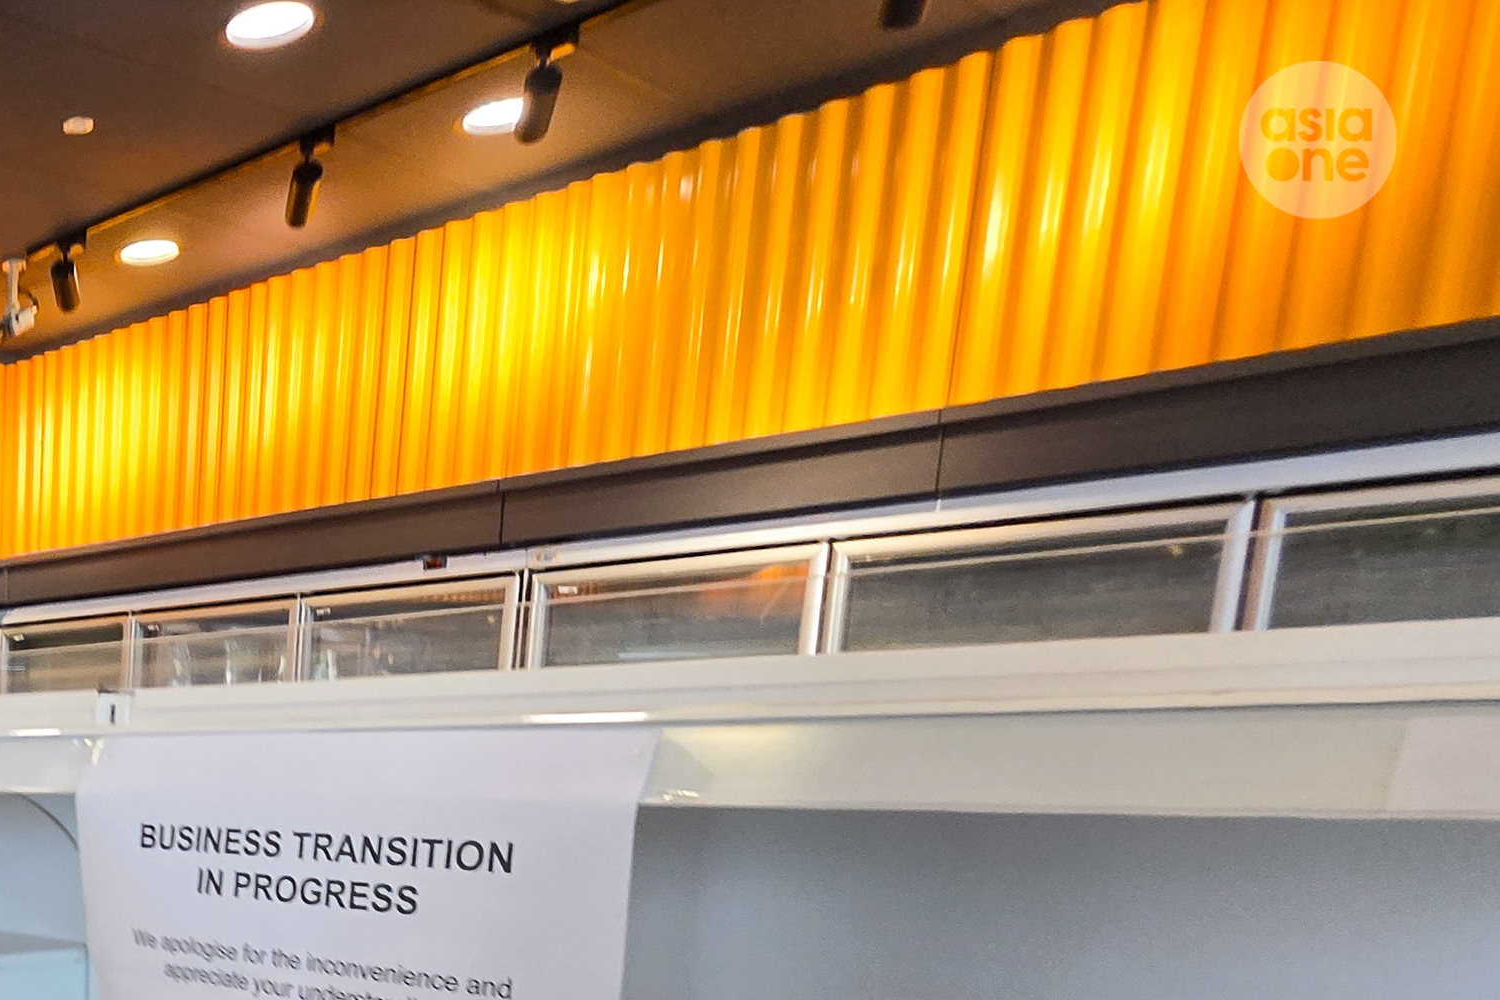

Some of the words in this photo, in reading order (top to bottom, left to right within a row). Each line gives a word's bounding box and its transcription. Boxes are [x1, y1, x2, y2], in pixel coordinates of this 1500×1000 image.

[139, 823, 282, 859] BUSINESS
[293, 831, 515, 874] TRANSITION
[196, 867, 224, 897] IN
[233, 873, 420, 915] PROGRESS
[132, 928, 157, 951] We
[160, 933, 239, 964] apologise
[242, 942, 268, 967] for
[270, 946, 302, 971] the
[306, 951, 459, 993] inconvenience
[465, 976, 513, 1000] and
[163, 962, 250, 993] appreciate
